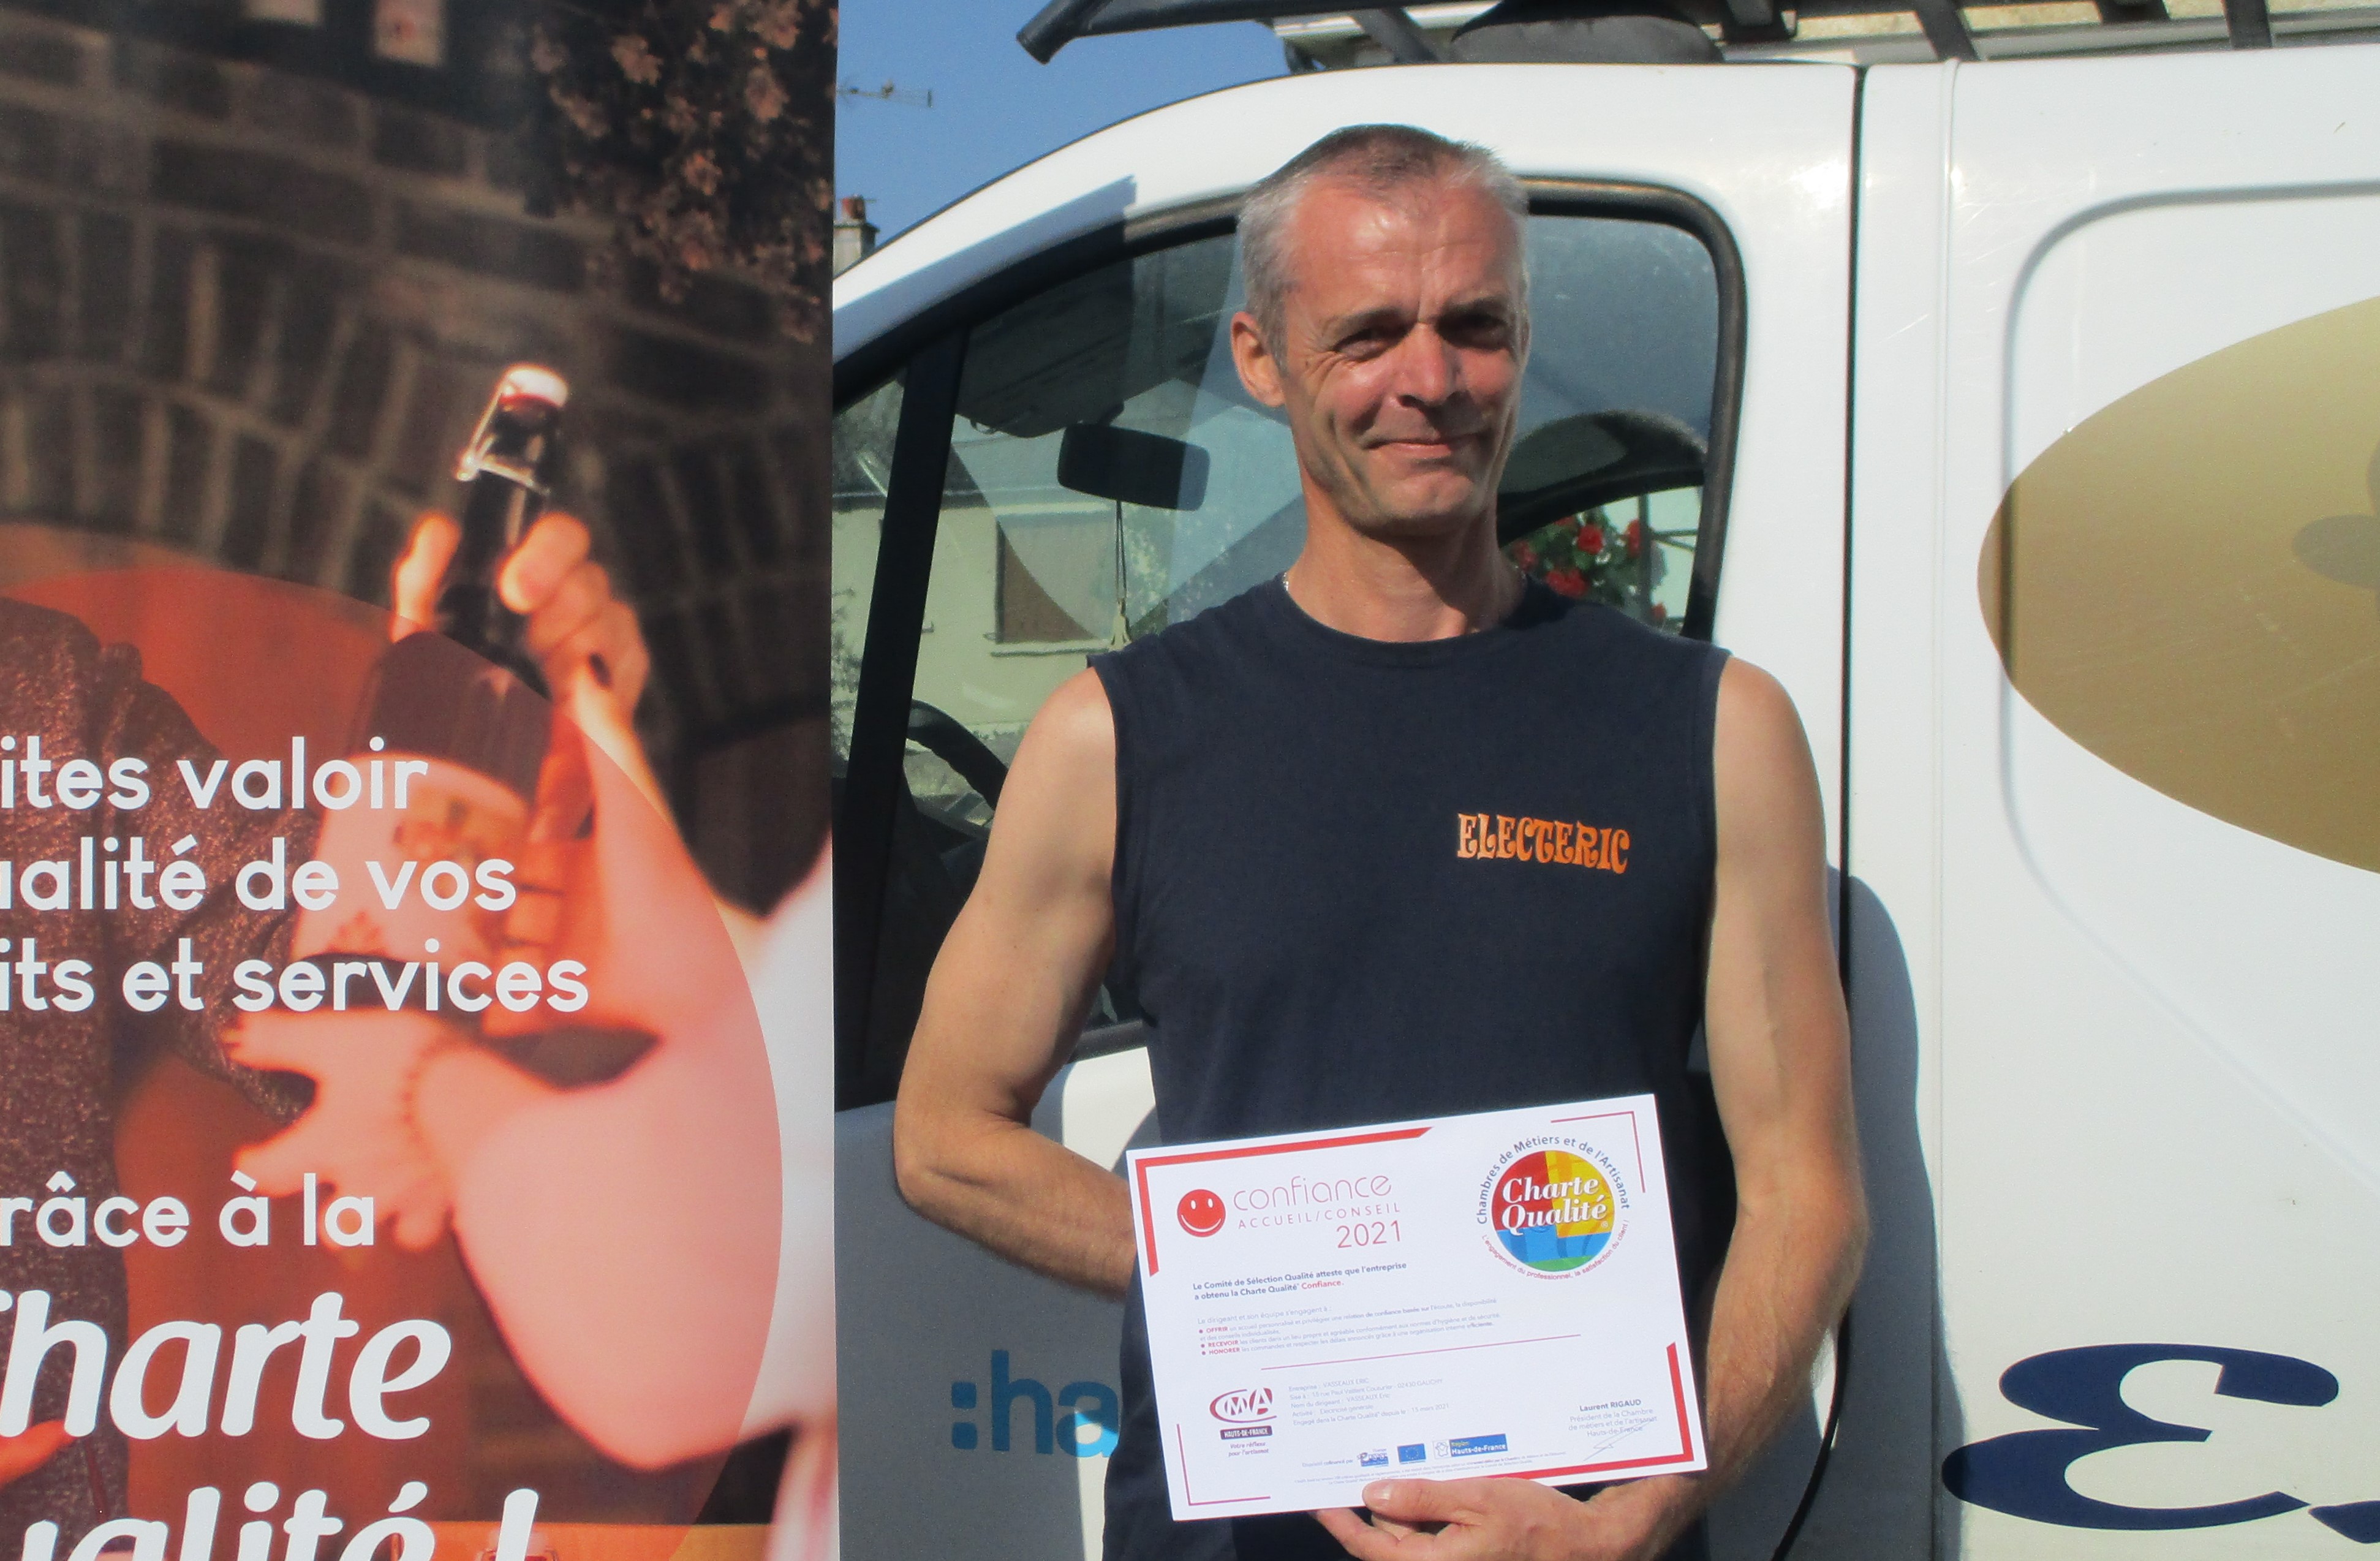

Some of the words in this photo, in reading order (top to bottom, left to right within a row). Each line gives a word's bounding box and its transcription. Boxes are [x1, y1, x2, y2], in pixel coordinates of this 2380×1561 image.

[1, 736, 149, 809] ites
[176, 736, 428, 810] valoir
[1457, 813, 1630, 874] ELECTERIC
[235, 837, 339, 910] de
[365, 859, 516, 910] vos
[123, 938, 205, 1012] et
[232, 938, 589, 1012] services
[1233, 1175, 1392, 1211] confiance
[1477, 1164, 1500, 1225] Chambres
[1499, 1151, 1514, 1164] de
[1513, 1136, 1560, 1154] Métiers
[1563, 1138, 1576, 1147] et
[1579, 1141, 1593, 1155] de
[1595, 1150, 1630, 1209] l'Artisanat
[1503, 1176, 1600, 1204] Charte
[219, 1170, 270, 1247] à
[303, 1173, 374, 1247] la
[1238, 1203, 1401, 1230] ACCUEIL/CONSEIL
[1502, 1195, 1606, 1236] Qualité
[1336, 1220, 1402, 1249] 2021
[1517, 1266, 1526, 1275] du
[1582, 1248, 1613, 1274] satisfaction
[1612, 1241, 1620, 1250] du
[1201, 1291, 1230, 1299] obtenu
[1240, 1287, 1266, 1296] Charte
[1301, 1280, 1344, 1290] Confiance.
[1204, 1280, 1233, 1289] Comité
[1247, 1276, 1283, 1285] Sélection
[1285, 1272, 1314, 1281] Qualité
[1316, 1269, 1342, 1279] atteste
[1361, 1262, 1407, 1273] l'entreprise
[1207, 1315, 1237, 1324] dirigeant
[1285, 1307, 1322, 1316] s'engagent
[0, 1290, 451, 1440] harte
[1209, 1387, 1277, 1423] CMA
[1570, 1413, 1601, 1423] Président
[1622, 1408, 1653, 1417] Chambre
[1611, 1399, 1641, 1408] RIGAUD
[1223, 1427, 1269, 1438] HAUTS-DE-FRANCE
[1579, 1421, 1604, 1429] métiers
[1625, 1416, 1657, 1424] l'artisanat
[1587, 1426, 1643, 1437] Hauts-de-France
[1452, 1444, 1506, 1455] Hauts-de-France
